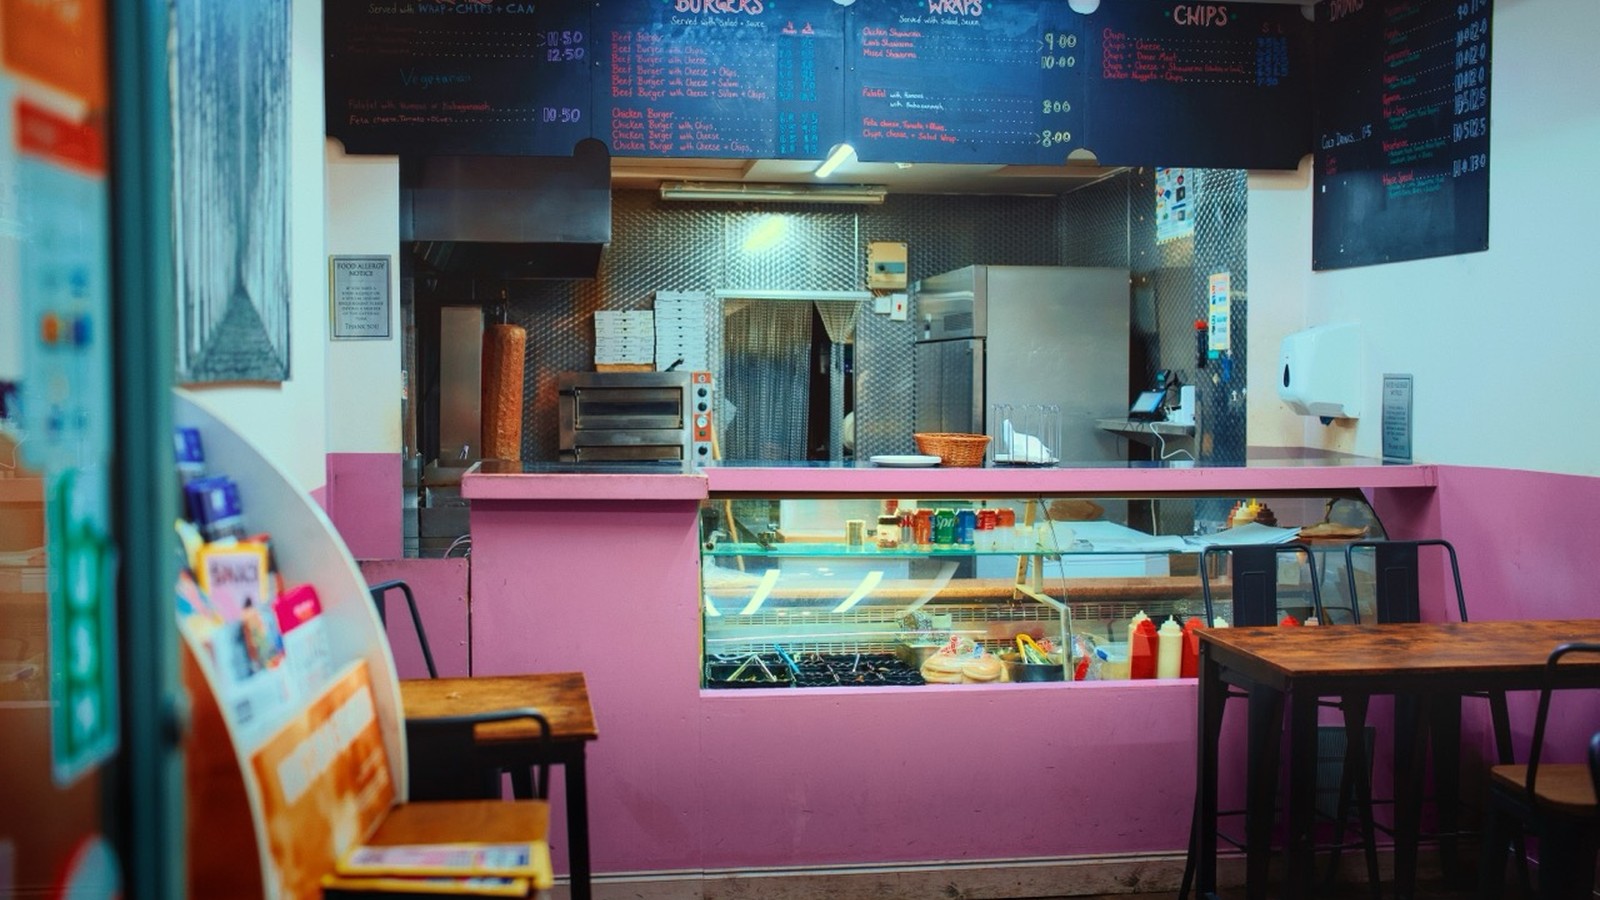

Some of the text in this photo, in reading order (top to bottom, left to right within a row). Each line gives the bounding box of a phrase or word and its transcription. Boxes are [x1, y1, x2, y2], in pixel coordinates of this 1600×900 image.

[368, 4, 397, 15] Served
[506, 4, 536, 14] CAN
[670, 16, 698, 26] Served
[611, 31, 632, 42] Beef
[611, 43, 631, 53] Beef
[636, 44, 663, 56] Burger
[1103, 39, 1126, 51] Chips
[1136, 40, 1161, 50] Cheese
[611, 54, 631, 64] Beef
[636, 54, 663, 67] Burger
[684, 56, 707, 65] Cheese
[611, 63, 631, 75] Beef
[636, 64, 665, 77] Burger
[684, 66, 708, 76] Cheese
[611, 74, 632, 86] Beef
[636, 75, 665, 88] Burger
[685, 77, 708, 87] Cheese
[611, 86, 632, 97] Beef
[637, 87, 666, 101] Burger
[686, 87, 709, 97] Cheese
[612, 107, 674, 120] Chicken Burger
[612, 119, 644, 130] Chicken
[648, 119, 673, 131] Burger
[694, 121, 713, 132] Chips
[612, 129, 644, 140] Chicken
[649, 129, 673, 142] Burger
[695, 131, 720, 140] Cheese
[613, 139, 645, 151] Chicken
[649, 139, 673, 153] Burger
[695, 142, 721, 151] Cheese
[730, 141, 750, 153] Chips
